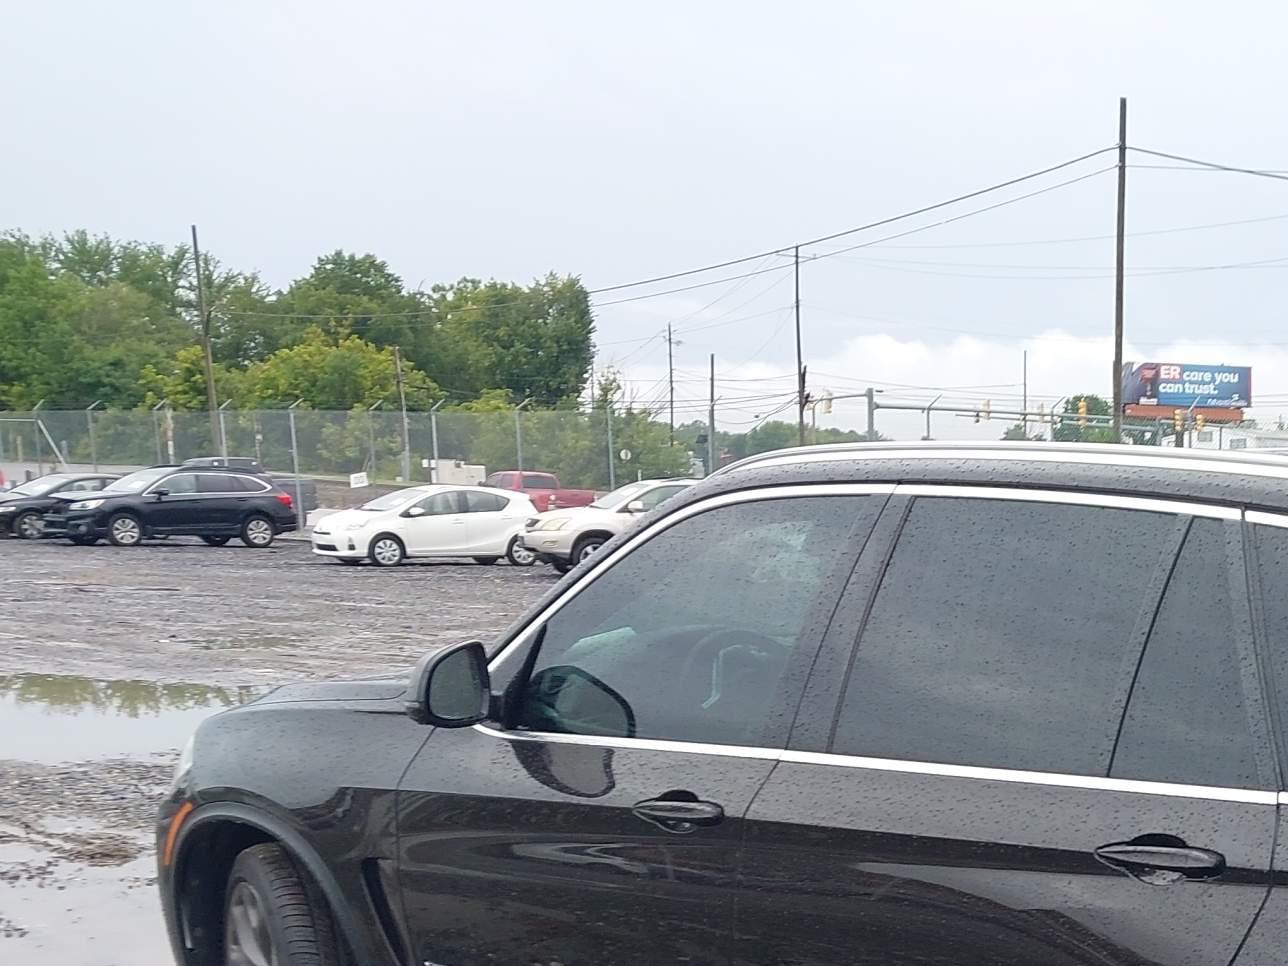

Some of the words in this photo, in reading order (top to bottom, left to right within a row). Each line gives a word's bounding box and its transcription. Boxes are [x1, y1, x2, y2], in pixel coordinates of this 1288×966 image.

[1160, 365, 1181, 379] ER
[1183, 370, 1213, 381] care
[1214, 372, 1239, 384] you
[1158, 382, 1183, 393] can
[1184, 382, 1219, 394] trust.
